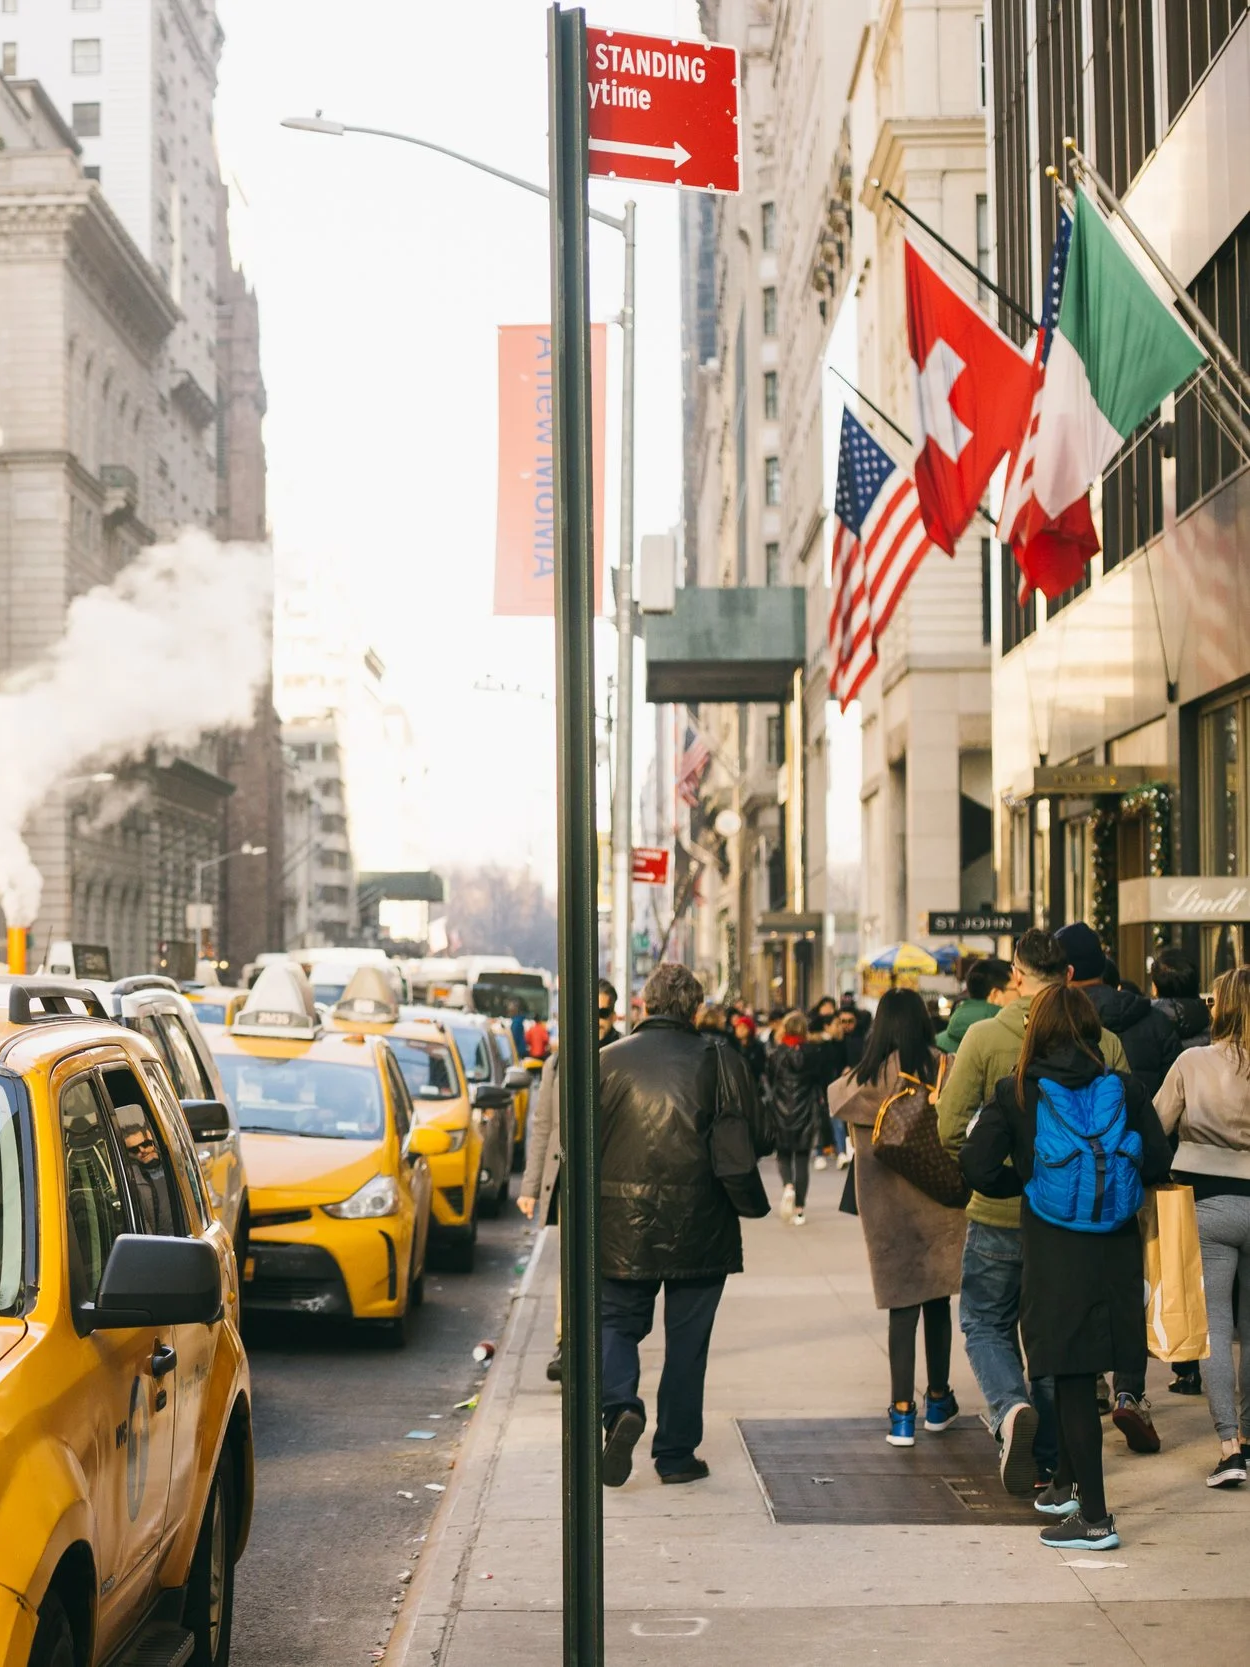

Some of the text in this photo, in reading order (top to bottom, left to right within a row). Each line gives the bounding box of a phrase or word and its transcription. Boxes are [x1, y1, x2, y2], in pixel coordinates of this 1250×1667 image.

[595, 43, 706, 84] STANDING
[588, 79, 651, 110] ytime
[1162, 884, 1248, 914] Lindt
[961, 916, 1012, 930] JOHN
[1086, 1527, 1109, 1537] HOKA
